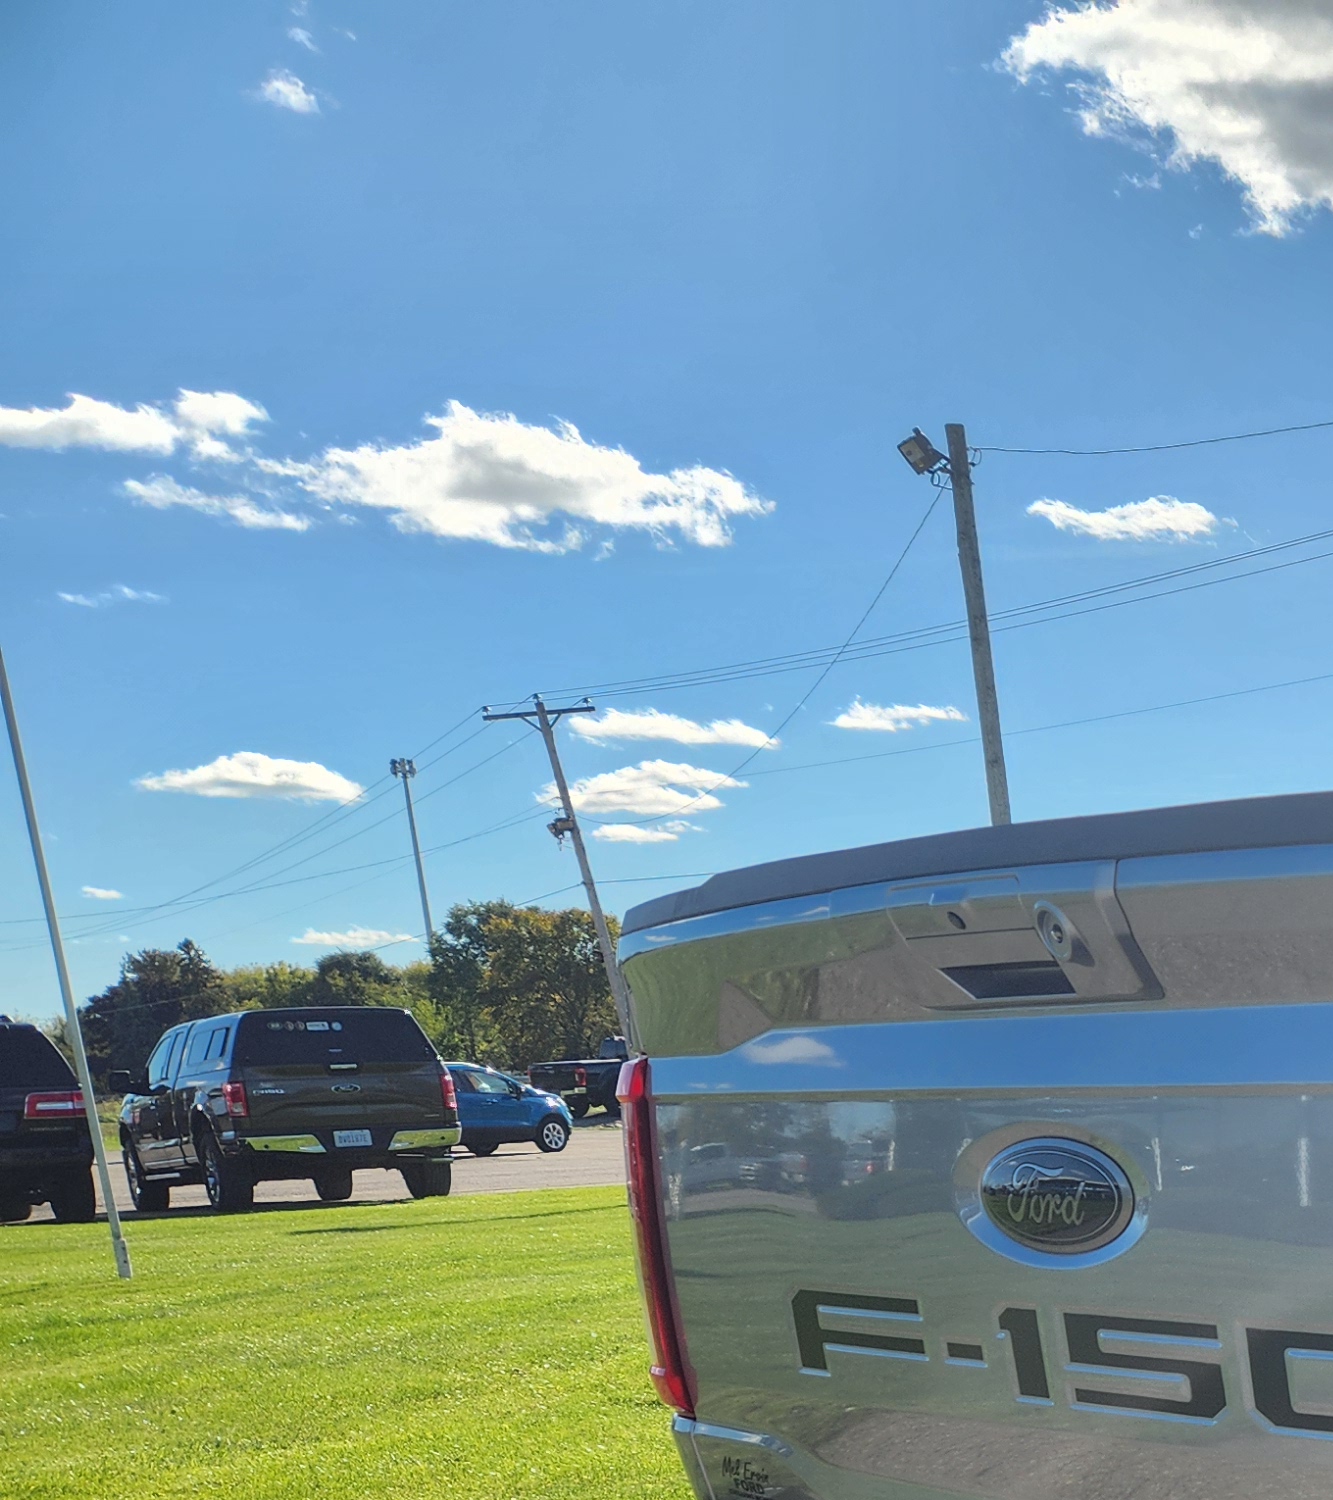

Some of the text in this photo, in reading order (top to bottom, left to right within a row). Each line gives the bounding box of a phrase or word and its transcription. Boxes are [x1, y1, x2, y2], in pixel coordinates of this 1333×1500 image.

[1007, 1162, 1085, 1226] Ford
[722, 1455, 741, 1478] Mel
[733, 1478, 765, 1495] FORD
